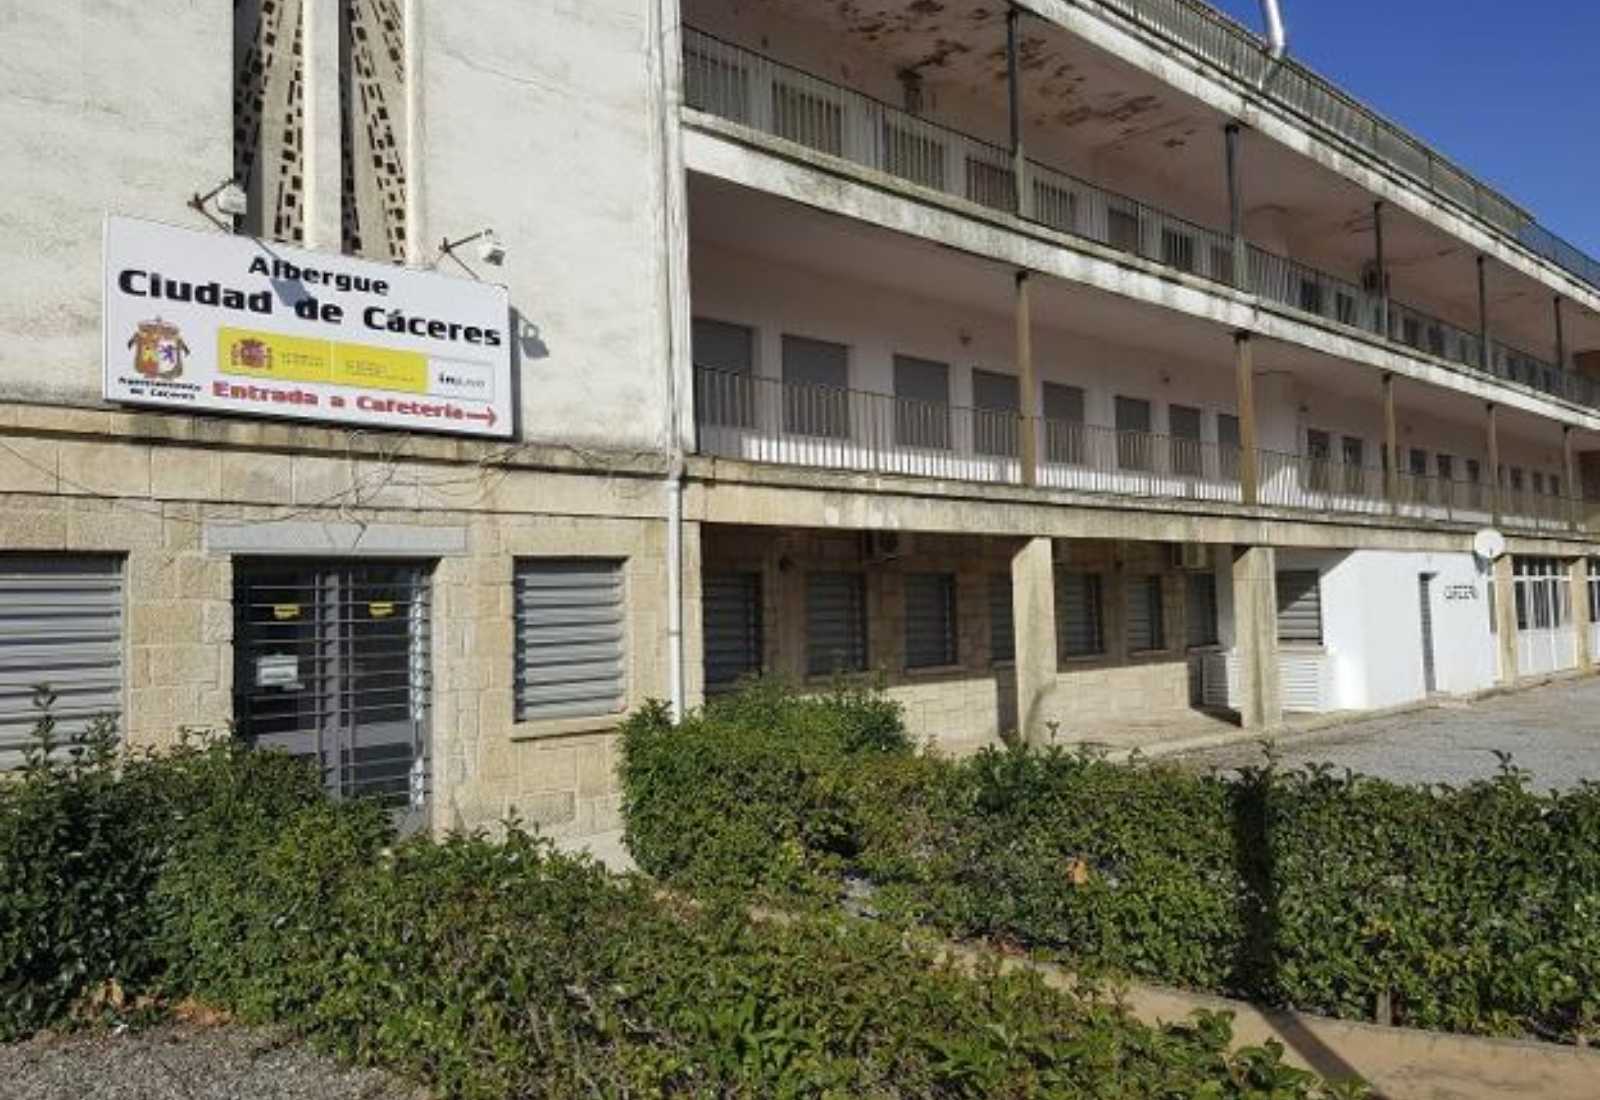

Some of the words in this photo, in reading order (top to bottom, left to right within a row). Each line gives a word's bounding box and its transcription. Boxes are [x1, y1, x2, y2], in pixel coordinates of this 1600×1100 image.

[248, 256, 389, 296] Albergue
[118, 269, 272, 314] Ciudad
[294, 298, 343, 325] de
[363, 306, 501, 346] Cáceres
[212, 381, 318, 406] Entrada
[331, 395, 346, 408] a
